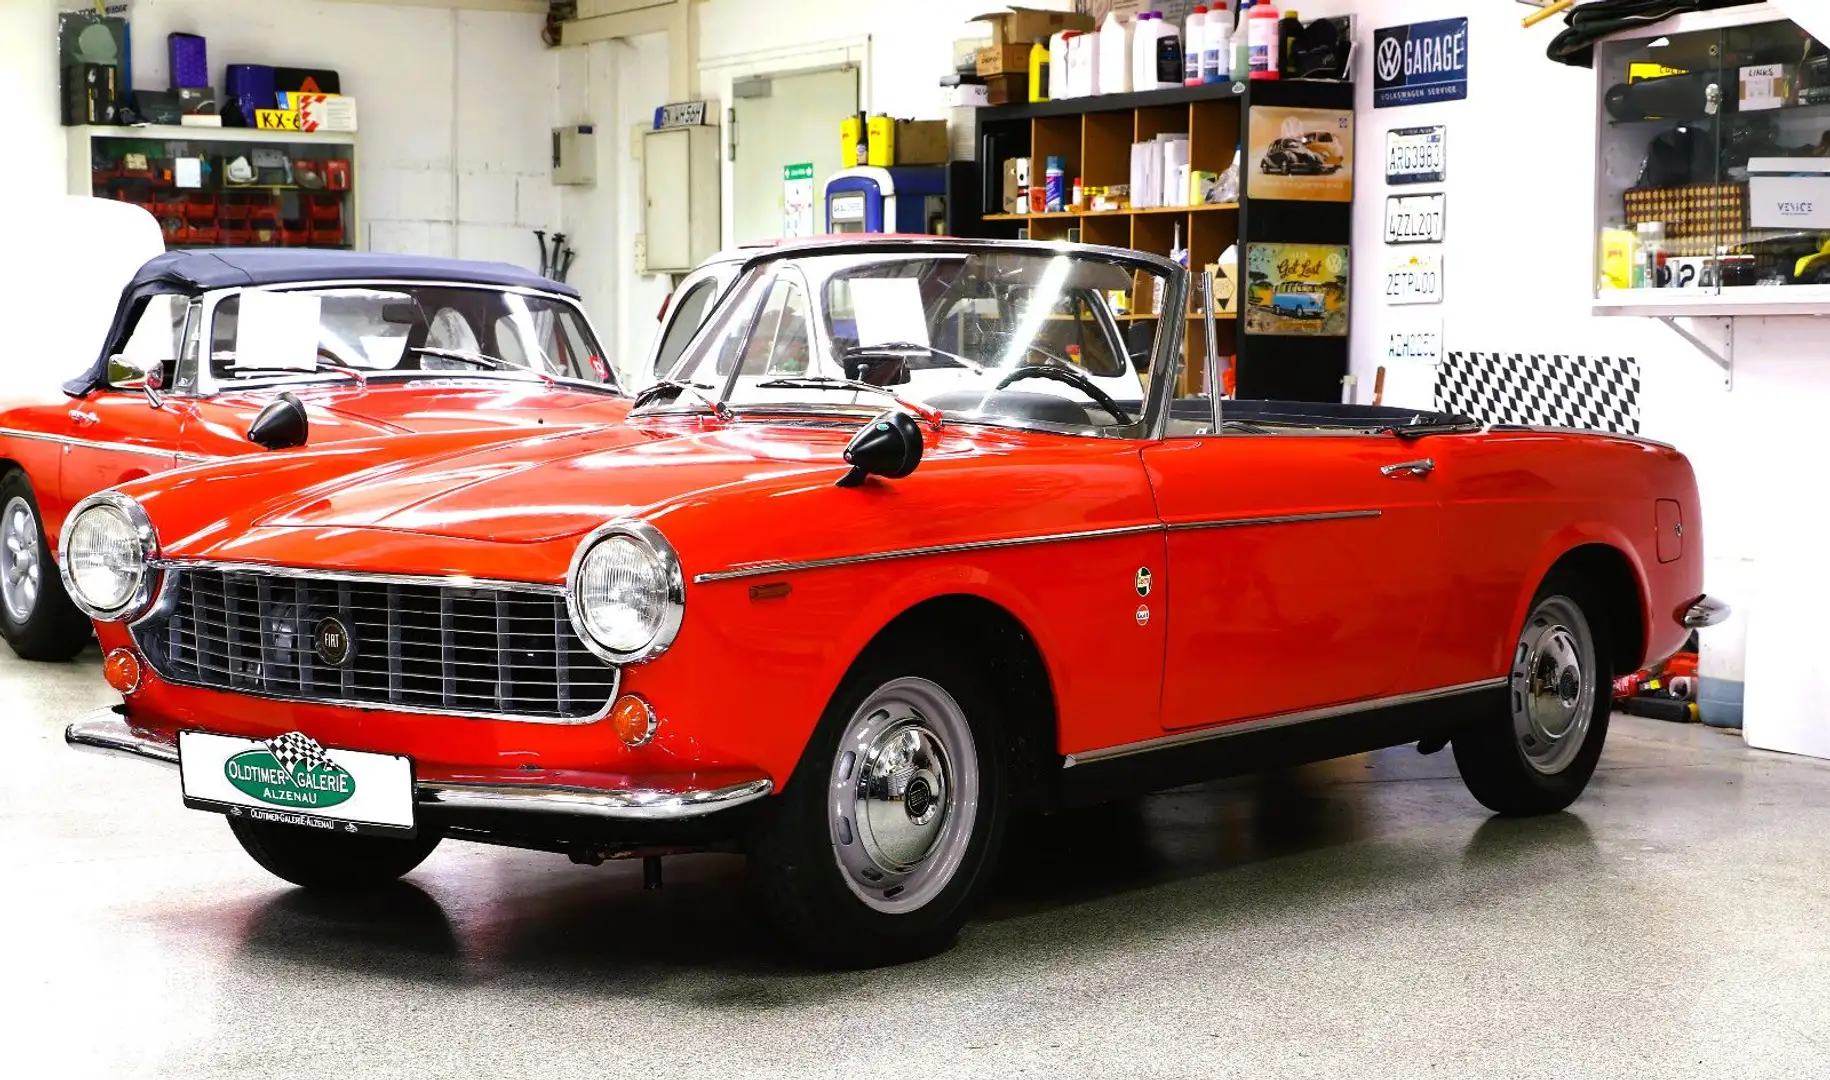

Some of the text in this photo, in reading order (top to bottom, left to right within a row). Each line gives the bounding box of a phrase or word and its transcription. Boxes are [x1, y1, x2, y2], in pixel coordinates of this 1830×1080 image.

[1404, 33, 1464, 76] GARAGE
[1748, 68, 1774, 77] LINKS
[1381, 85, 1457, 101] VOLKSWAGEN SERVICE
[324, 632, 340, 648] FIAT
[297, 772, 349, 793] GALERIE
[263, 787, 317, 805] ALZENAU
